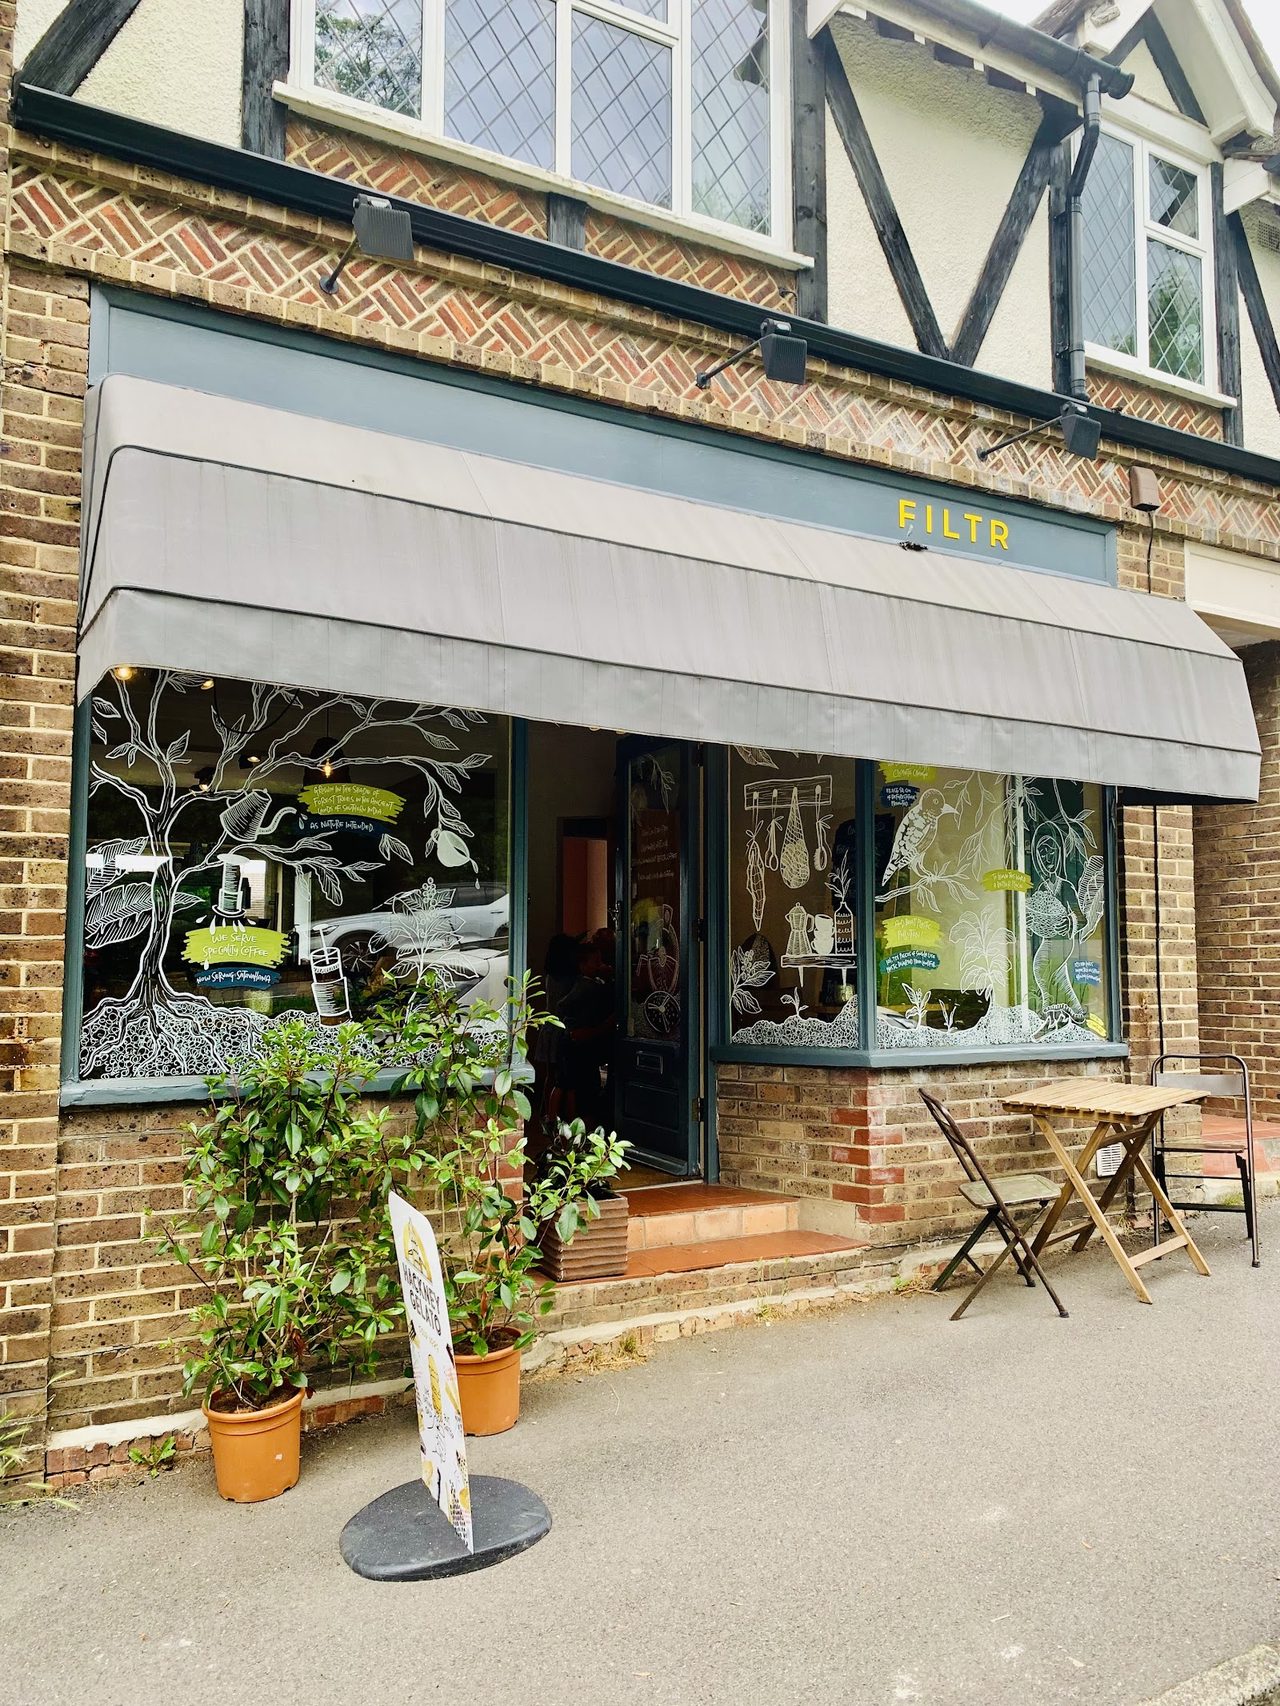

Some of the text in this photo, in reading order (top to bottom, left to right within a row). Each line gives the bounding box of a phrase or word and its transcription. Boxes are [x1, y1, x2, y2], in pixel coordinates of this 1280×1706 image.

[898, 499, 1009, 550] FILTR
[309, 822, 319, 830] AS
[320, 819, 344, 830] NATURE
[211, 932, 257, 947] WE SERVE
[240, 945, 269, 958] COFFEE
[196, 974, 211, 984] NOW
[402, 1262, 441, 1315] HACKNEY
[409, 1289, 442, 1336] GELATO
